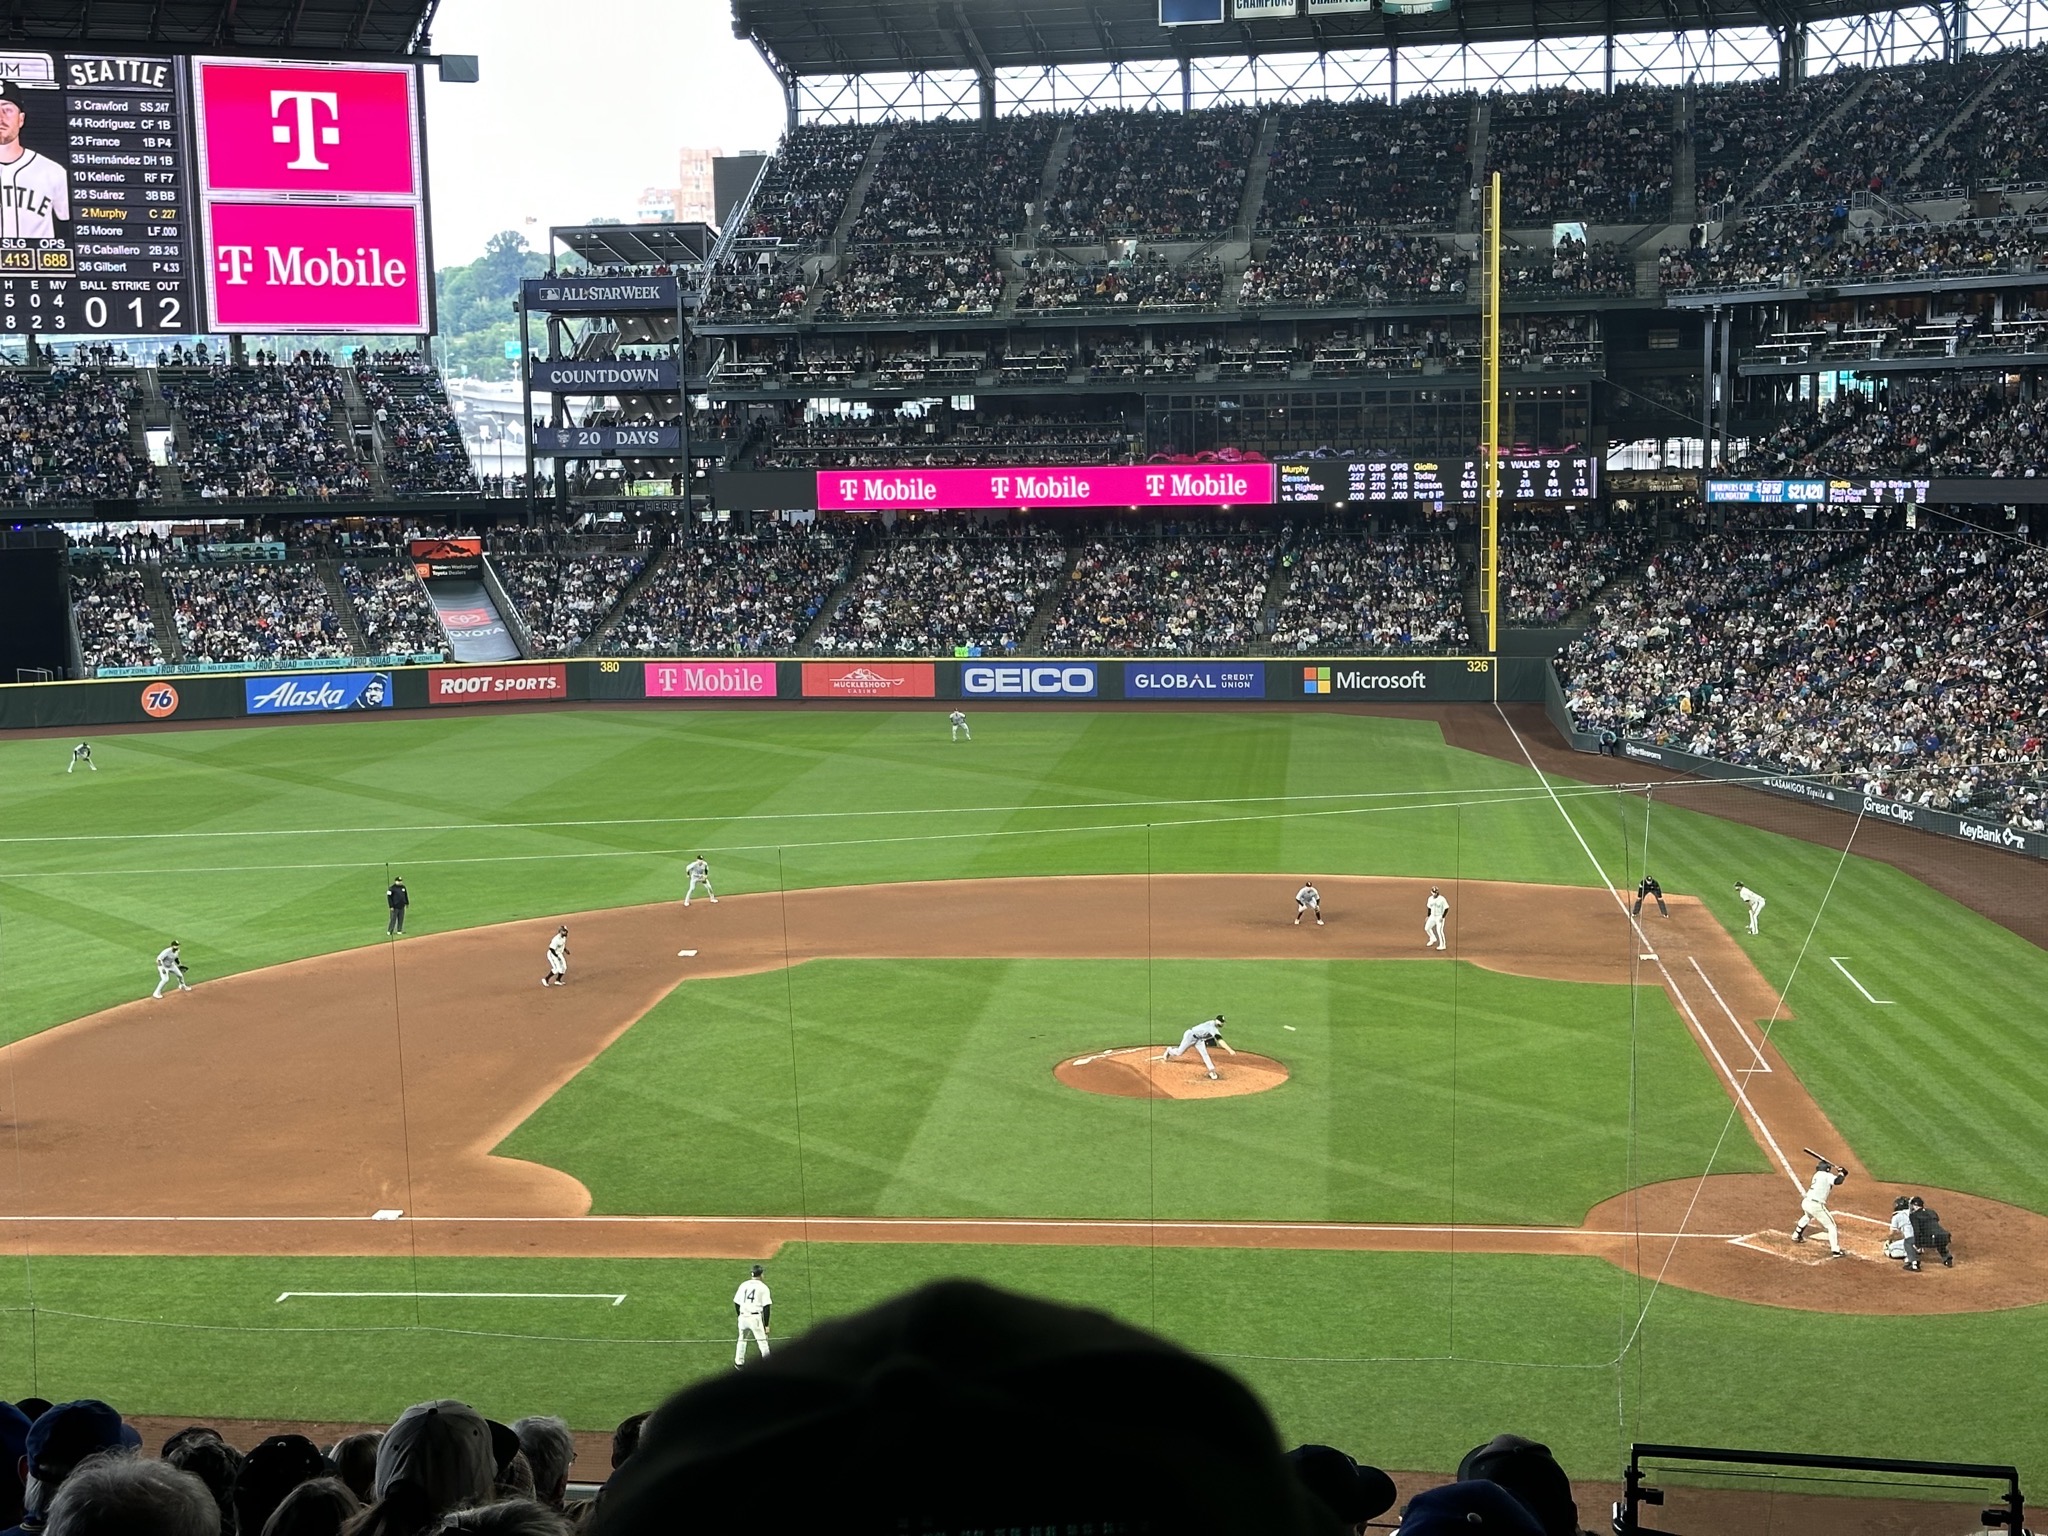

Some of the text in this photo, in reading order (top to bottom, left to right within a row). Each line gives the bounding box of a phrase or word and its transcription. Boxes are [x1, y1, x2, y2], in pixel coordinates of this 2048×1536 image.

[71, 60, 168, 88] SEATTLE
[75, 100, 170, 112] 3 Crawford SS .247
[69, 118, 171, 130] 44 Rodríguez CF 1B
[270, 90, 340, 170] T
[70, 136, 172, 147] 23 France 1B P4
[72, 154, 173, 166] 35 Hernández DH 1B
[74, 172, 174, 183] 10 Kelenic RF F7
[74, 190, 175, 201] 28 Suárez 3B BB
[82, 208, 176, 220] 2 Murphy C .227
[76, 226, 178, 236] 25 Moore LF .000
[2, 239, 65, 248] SLG OPS
[77, 245, 179, 255] 76 Caballero 2B .243
[2, 253, 68, 267] .413 .688
[79, 262, 180, 272] 36 Gilbert P 4.33
[218, 246, 406, 287] T Mobile
[4, 280, 66, 290] H E MV
[80, 281, 180, 291] BALL STRIKE OUT
[620, 286, 660, 299] WEEK
[4, 294, 64, 308] 5 0 4
[85, 296, 182, 328] 0 1 2
[6, 315, 65, 329] 8 2 3
[550, 368, 659, 384] COUNTDOWN
[578, 432, 600, 445] 20
[616, 431, 659, 445] DAYS
[1282, 466, 1309, 474] Murphy
[1348, 464, 1365, 472] AVG
[1368, 464, 1386, 472] OBP
[1510, 460, 1540, 468] WALKS
[1547, 460, 1560, 468] SO
[1573, 460, 1586, 468] HR
[1282, 474, 1310, 482] Season
[1414, 472, 1436, 481] Today
[1462, 471, 1475, 479] 4.2
[1522, 470, 1528, 478] 3
[840, 478, 936, 500] T Mobile
[991, 476, 1090, 498] T Mobile
[1146, 474, 1247, 496] T Mobile
[1295, 484, 1324, 492] Righties
[1888, 480, 1911, 488] Strikes
[1913, 480, 1930, 488] Total
[1436, 490, 1444, 498] IP
[1463, 490, 1475, 498] 9.0
[1788, 484, 1824, 500] $21,420
[1847, 488, 1867, 496] Count
[178, 665, 200, 673] SQUAD
[369, 656, 391, 664] SQUAD
[600, 662, 620, 673] 380
[1467, 661, 1488, 672] 326
[440, 677, 557, 694] ROOT SPORTS
[658, 668, 763, 692] T Mobile
[964, 667, 1094, 693] GEICO
[1135, 674, 1216, 688] GLOBAL
[1336, 670, 1426, 689] Microsoft
[147, 689, 174, 710] 76
[253, 681, 345, 708] Alaska
[1771, 779, 1805, 794] CASAMIGOS
[1864, 797, 1914, 823] Great Clips
[1960, 821, 2001, 844] KeyBank
[744, 1289, 756, 1303] 14
